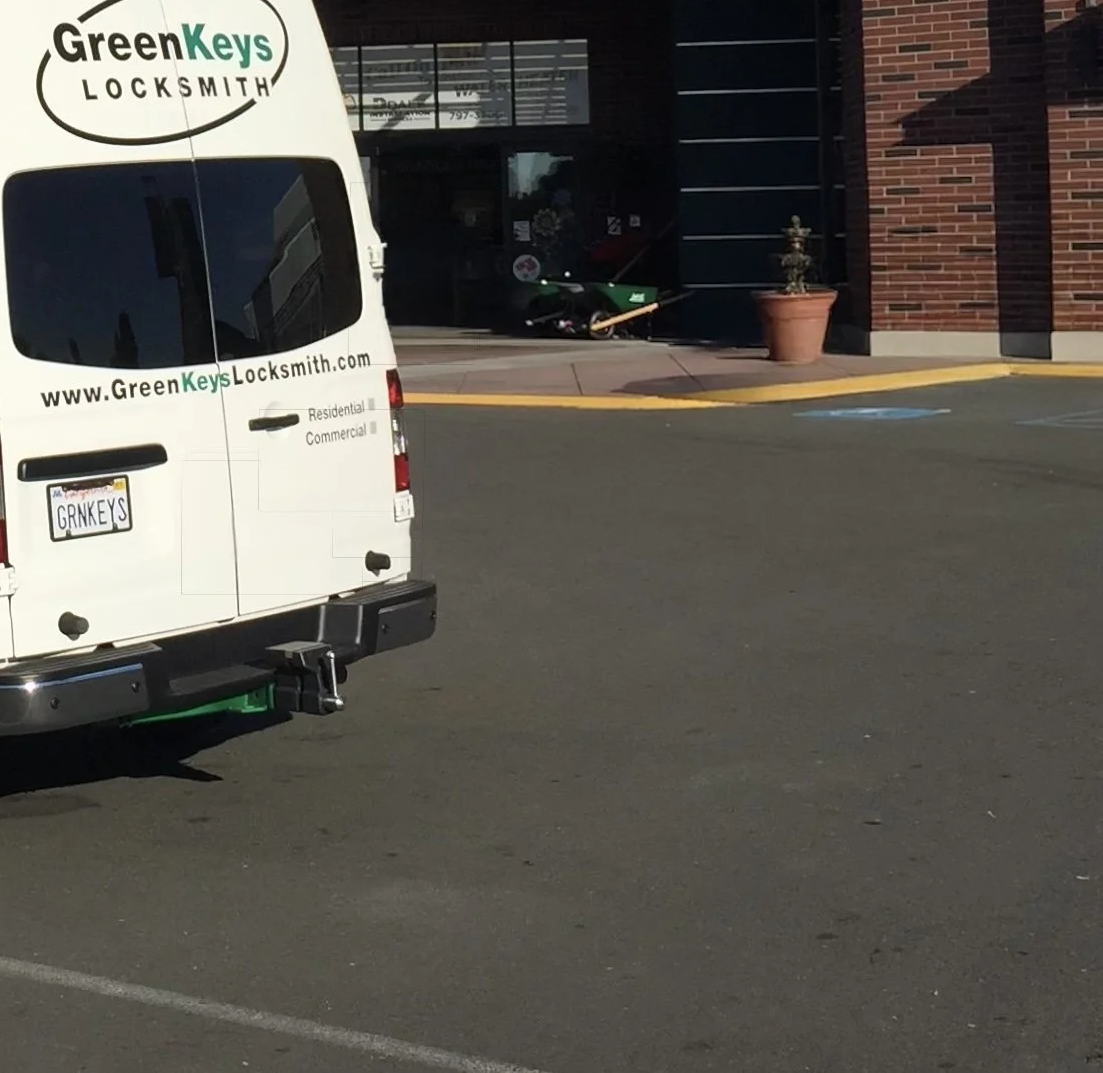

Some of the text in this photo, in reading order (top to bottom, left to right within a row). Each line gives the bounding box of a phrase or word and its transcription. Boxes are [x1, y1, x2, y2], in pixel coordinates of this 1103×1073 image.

[53, 22, 274, 69] GreenKeys
[82, 76, 270, 101] LOCKSMITH
[40, 350, 372, 408] www.GreenKeysLocksmith.com
[308, 399, 365, 422] Residential
[305, 424, 367, 446] Commercial
[57, 497, 127, 530] GRNKEYS
